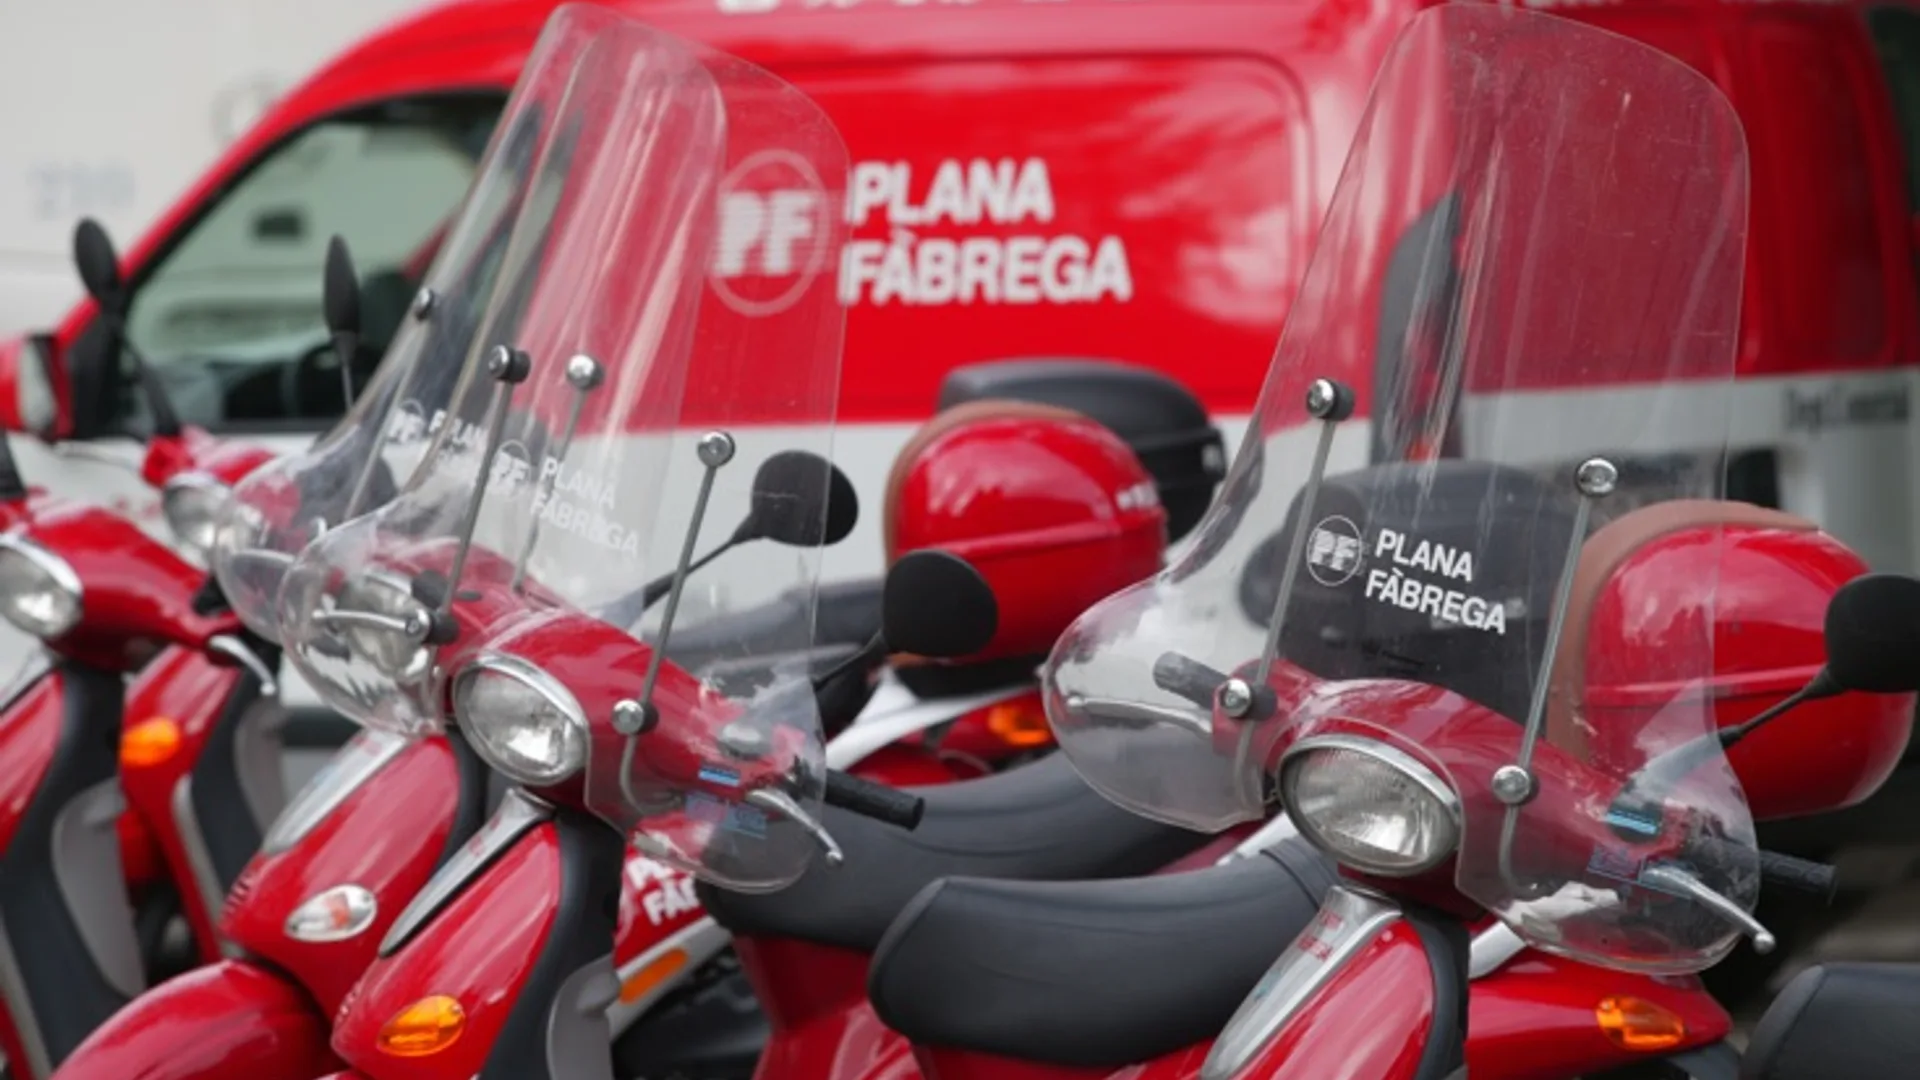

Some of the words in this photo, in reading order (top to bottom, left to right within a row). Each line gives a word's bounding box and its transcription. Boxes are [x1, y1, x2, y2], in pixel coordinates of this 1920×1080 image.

[844, 157, 1054, 226] PLANA
[712, 188, 815, 277] PF
[836, 227, 1133, 305] FÀBREGA
[1310, 528, 1359, 571] PF
[1374, 528, 1473, 583] PLANA
[1364, 566, 1506, 635] FÀBREGA
